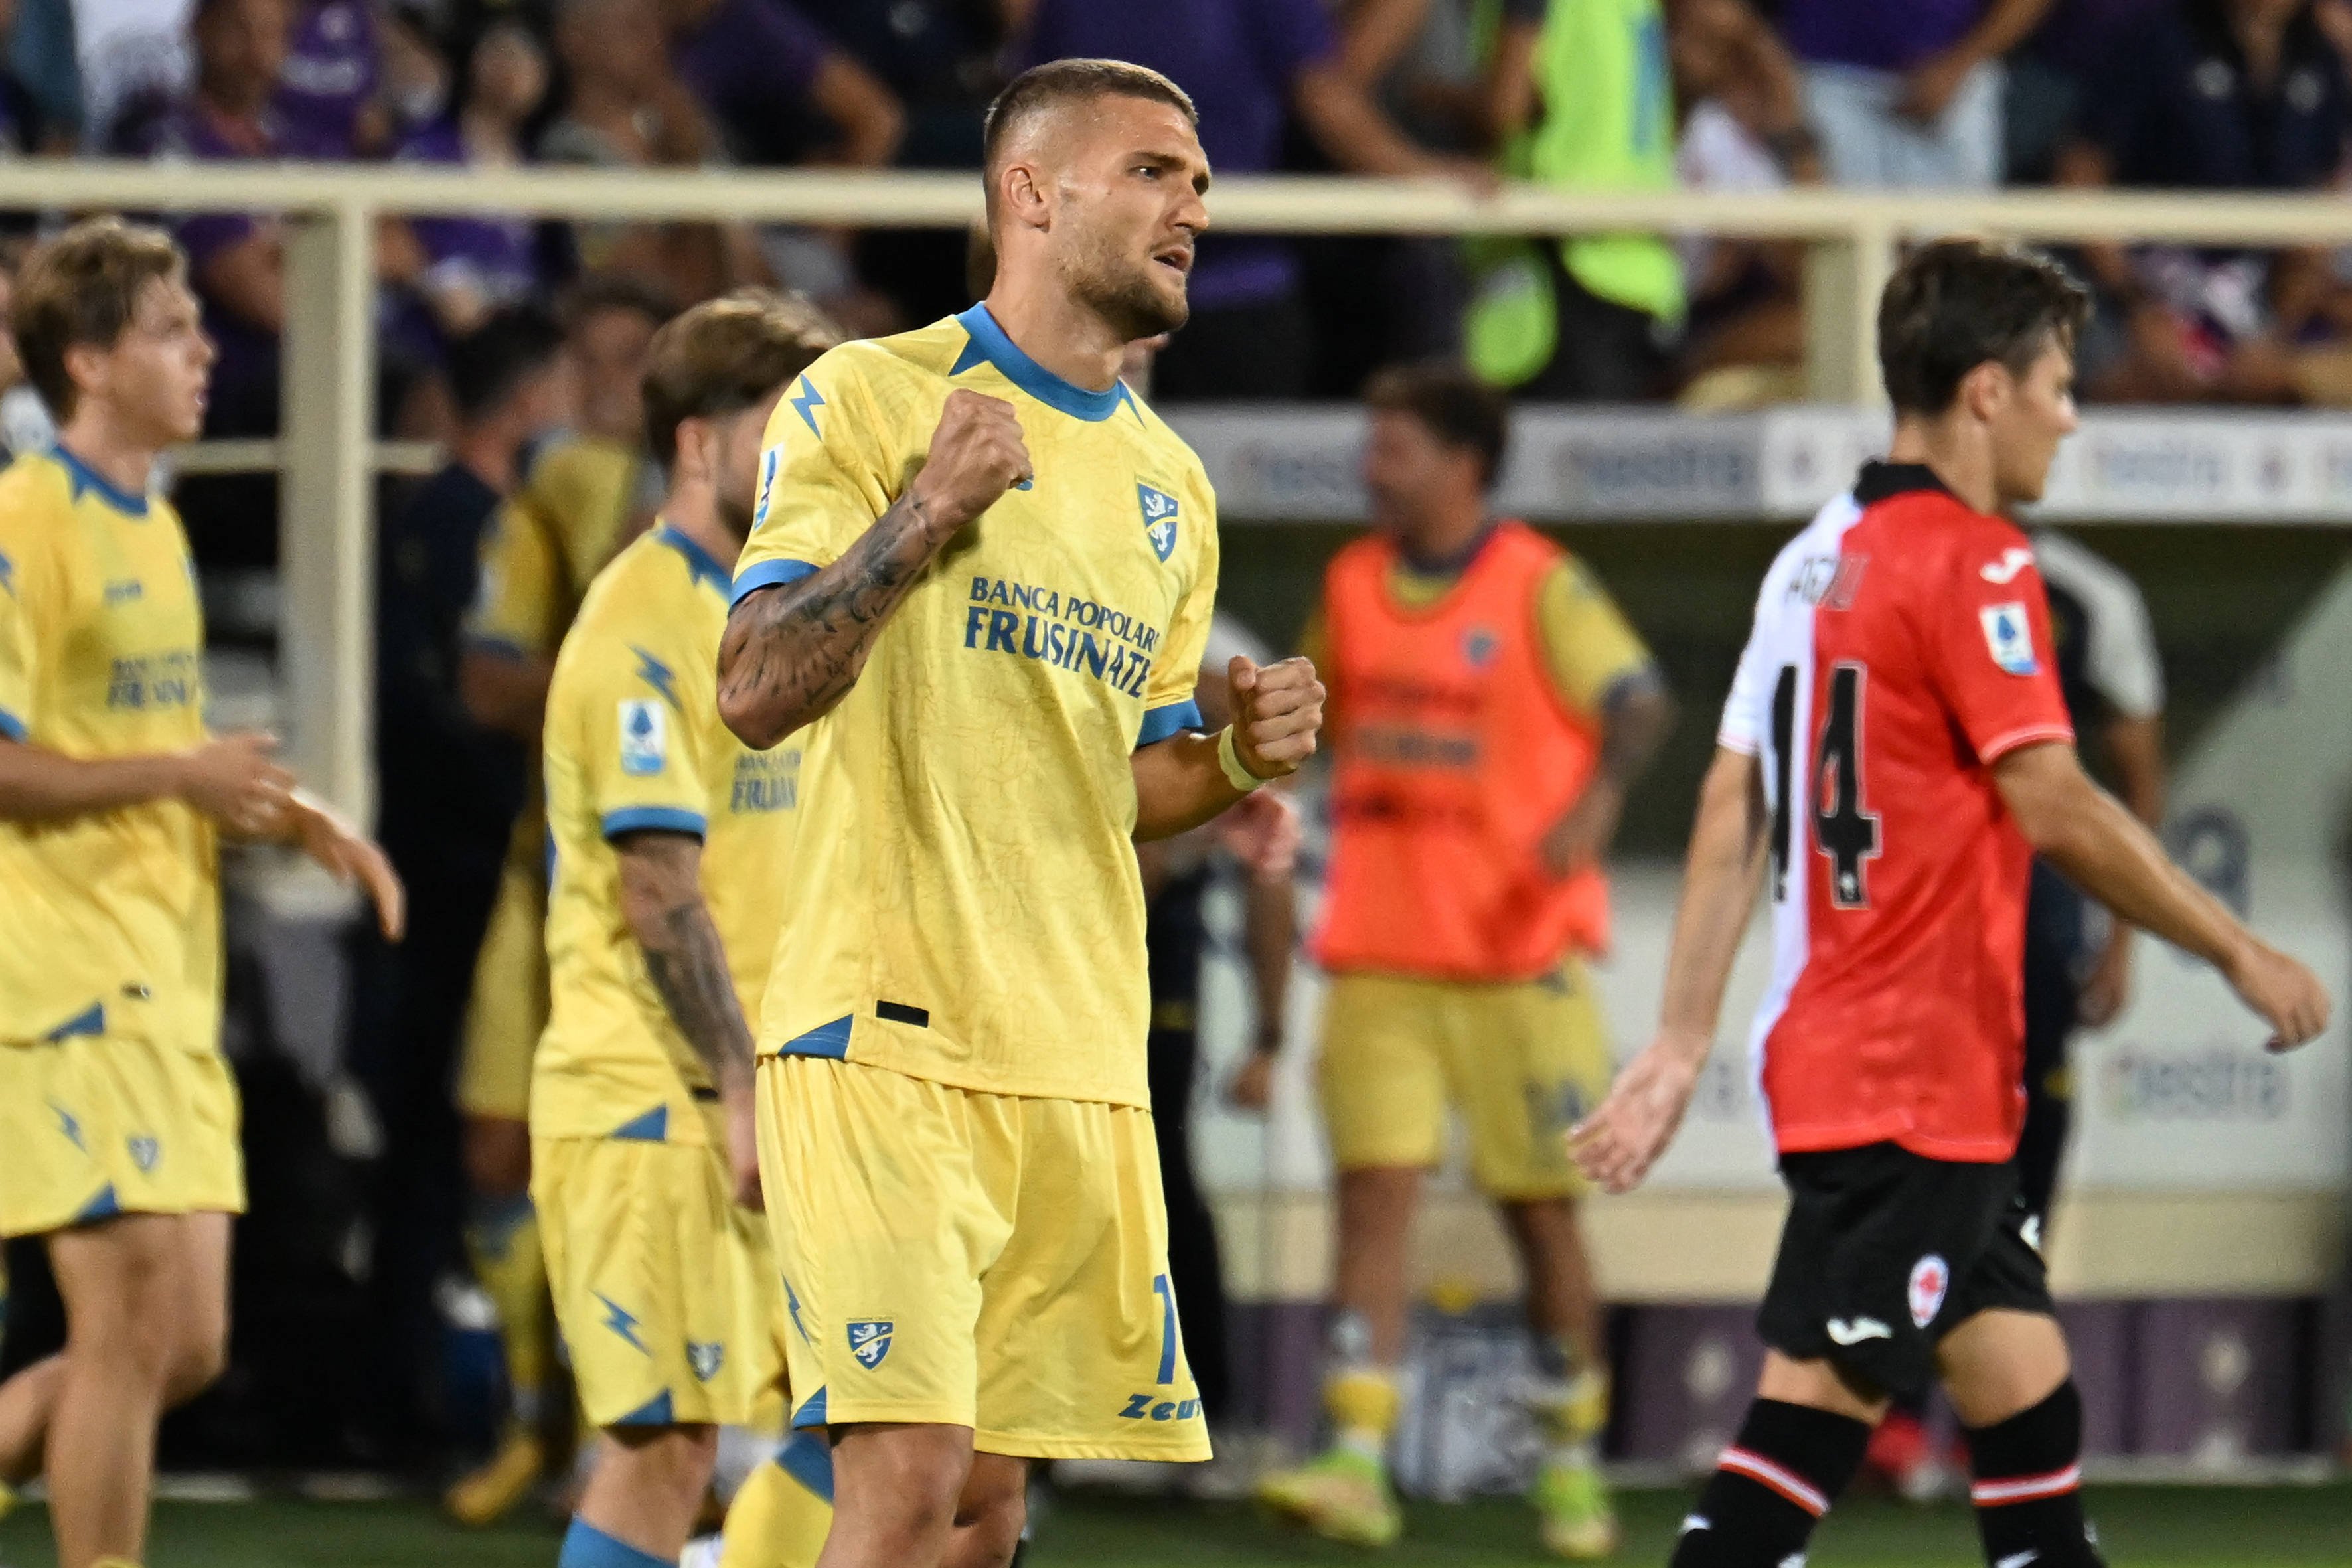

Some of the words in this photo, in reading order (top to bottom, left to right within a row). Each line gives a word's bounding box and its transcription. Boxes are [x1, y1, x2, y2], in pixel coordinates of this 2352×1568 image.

[970, 576, 1059, 617] BANCA
[964, 605, 1151, 699] FRUSINATE
[1771, 663, 1883, 909] 14
[1154, 1273, 1194, 1385] 1
